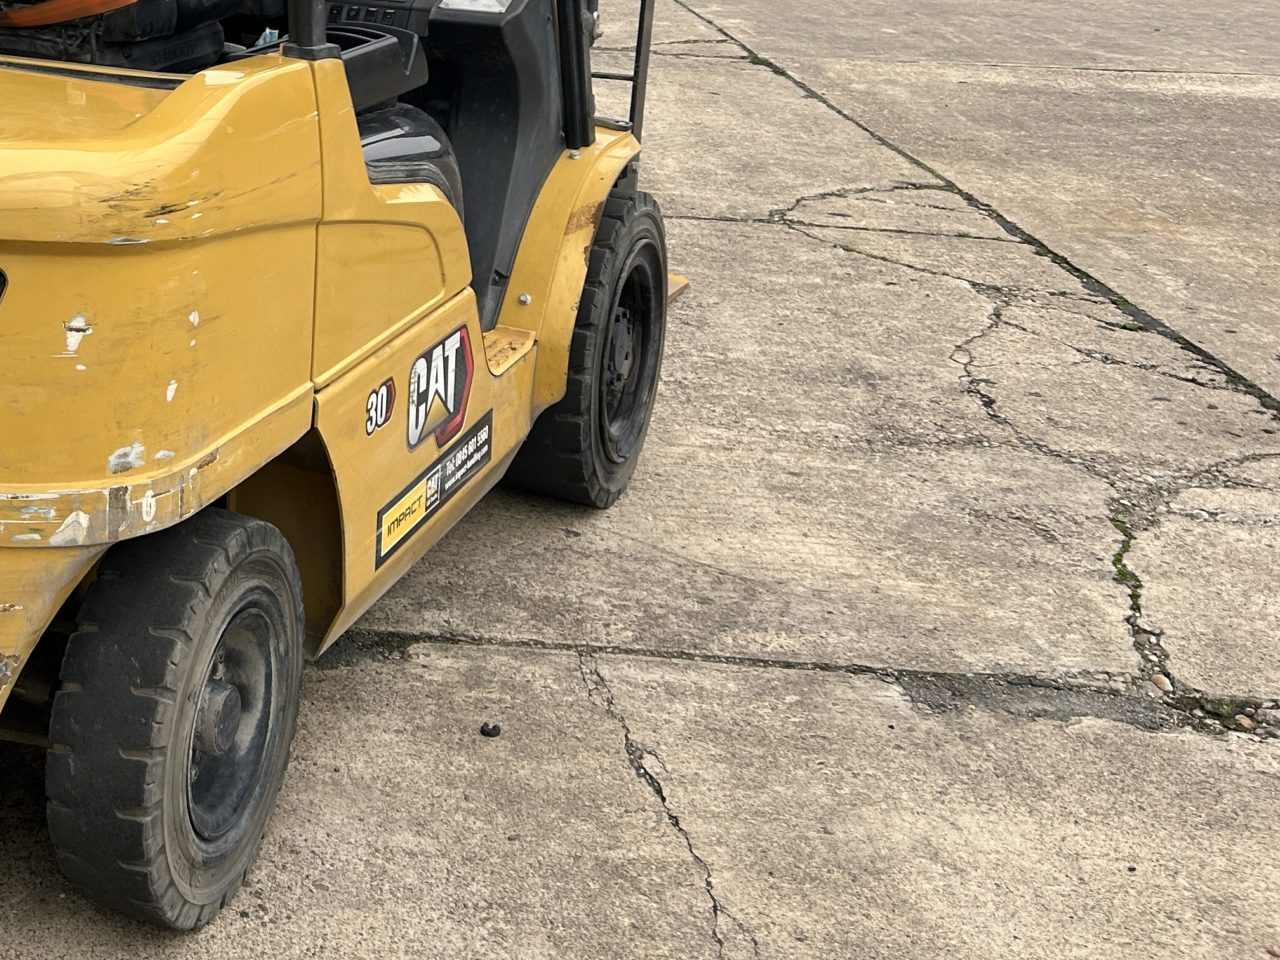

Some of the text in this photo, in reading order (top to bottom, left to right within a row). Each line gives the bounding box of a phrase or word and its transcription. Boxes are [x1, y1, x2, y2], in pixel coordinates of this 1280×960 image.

[366, 384, 388, 433] 30
[408, 330, 461, 446] CAT
[387, 494, 423, 537] IMPACT
